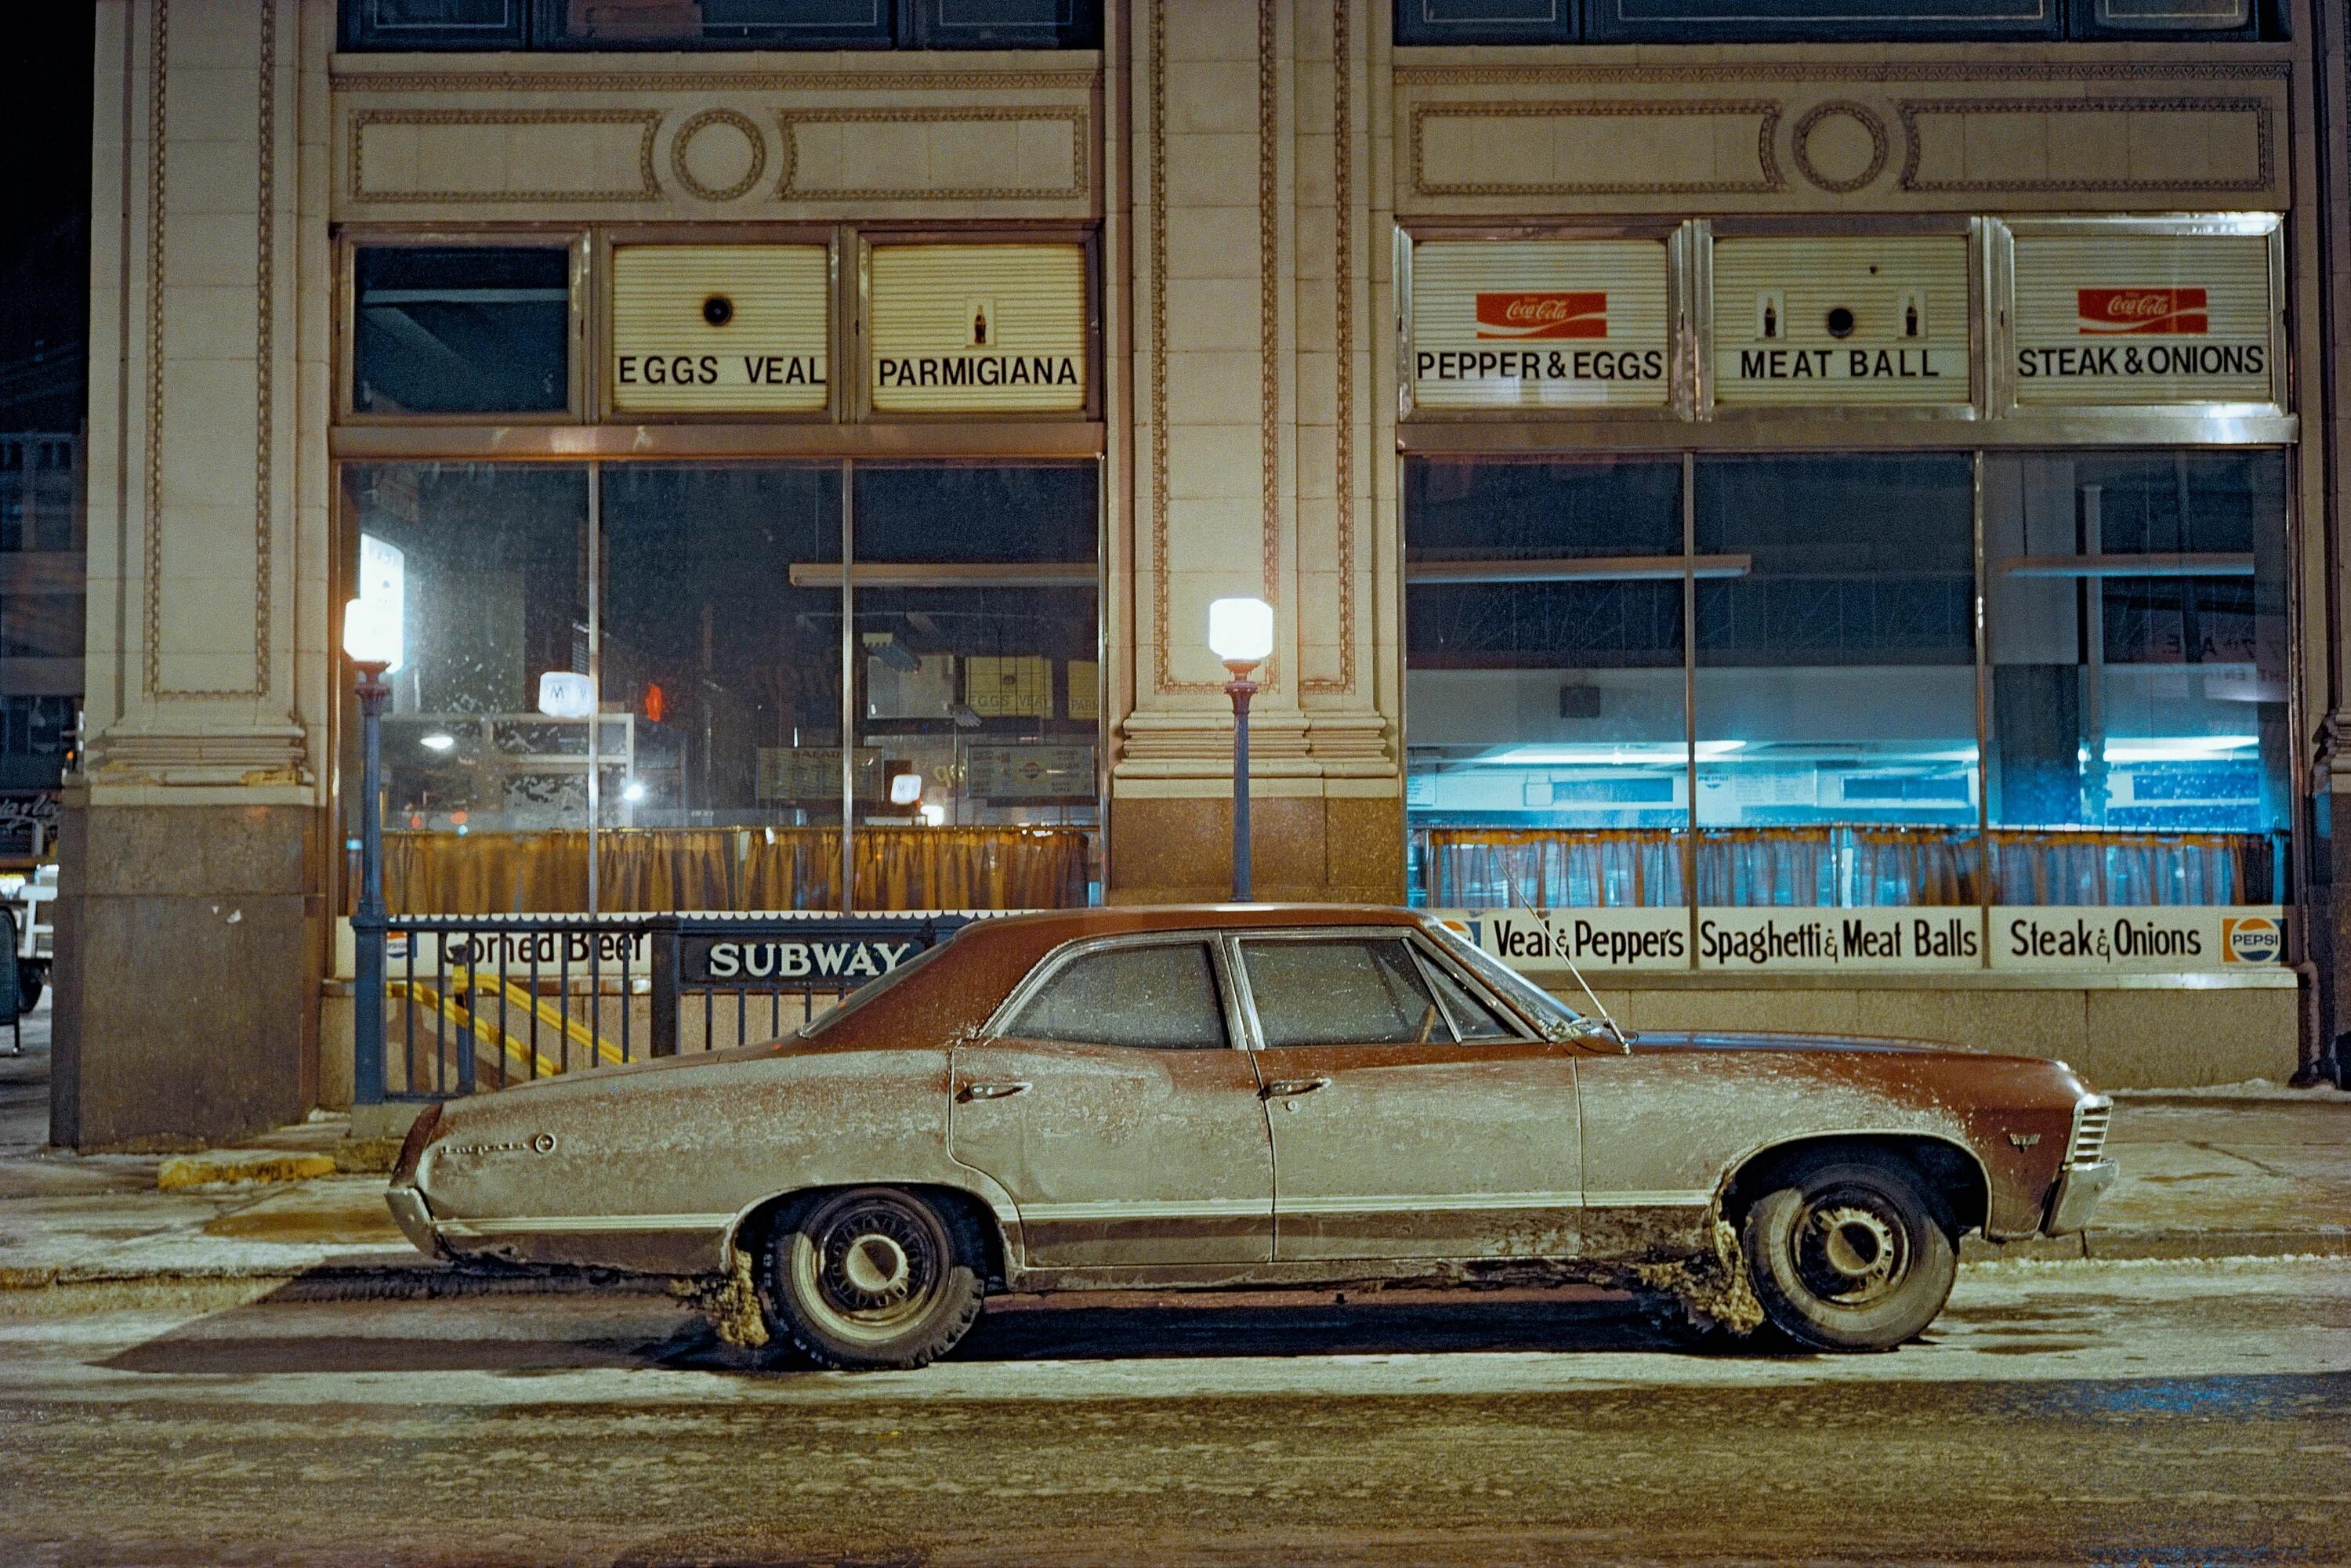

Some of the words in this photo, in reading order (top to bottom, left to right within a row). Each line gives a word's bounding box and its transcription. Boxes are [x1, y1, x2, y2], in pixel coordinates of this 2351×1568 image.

[1506, 299, 1569, 320] Coca-Cola
[2107, 295, 2169, 316] Coca-Cola
[619, 356, 718, 384] EGGS
[744, 356, 826, 384] VEAL
[878, 357, 1078, 386] PARMIGIANA
[1416, 352, 1541, 379] PEPPER
[1547, 351, 1567, 378] &
[1574, 350, 1662, 379] EGGS
[1741, 349, 1833, 378] MEAT
[1849, 349, 1940, 378] BALL
[2018, 347, 2117, 377] STEAK
[2124, 346, 2143, 375] &
[2147, 346, 2264, 375] ONIONS
[1494, 920, 1551, 957] Veal
[1700, 920, 1821, 965] Spaghetti
[1842, 919, 1902, 958] Meat
[1914, 918, 1978, 958] Balls
[2010, 918, 2094, 957] Steak
[2114, 918, 2202, 957] Onions
[2232, 933, 2279, 947] PEPSI
[709, 941, 911, 978] SUBWAY
